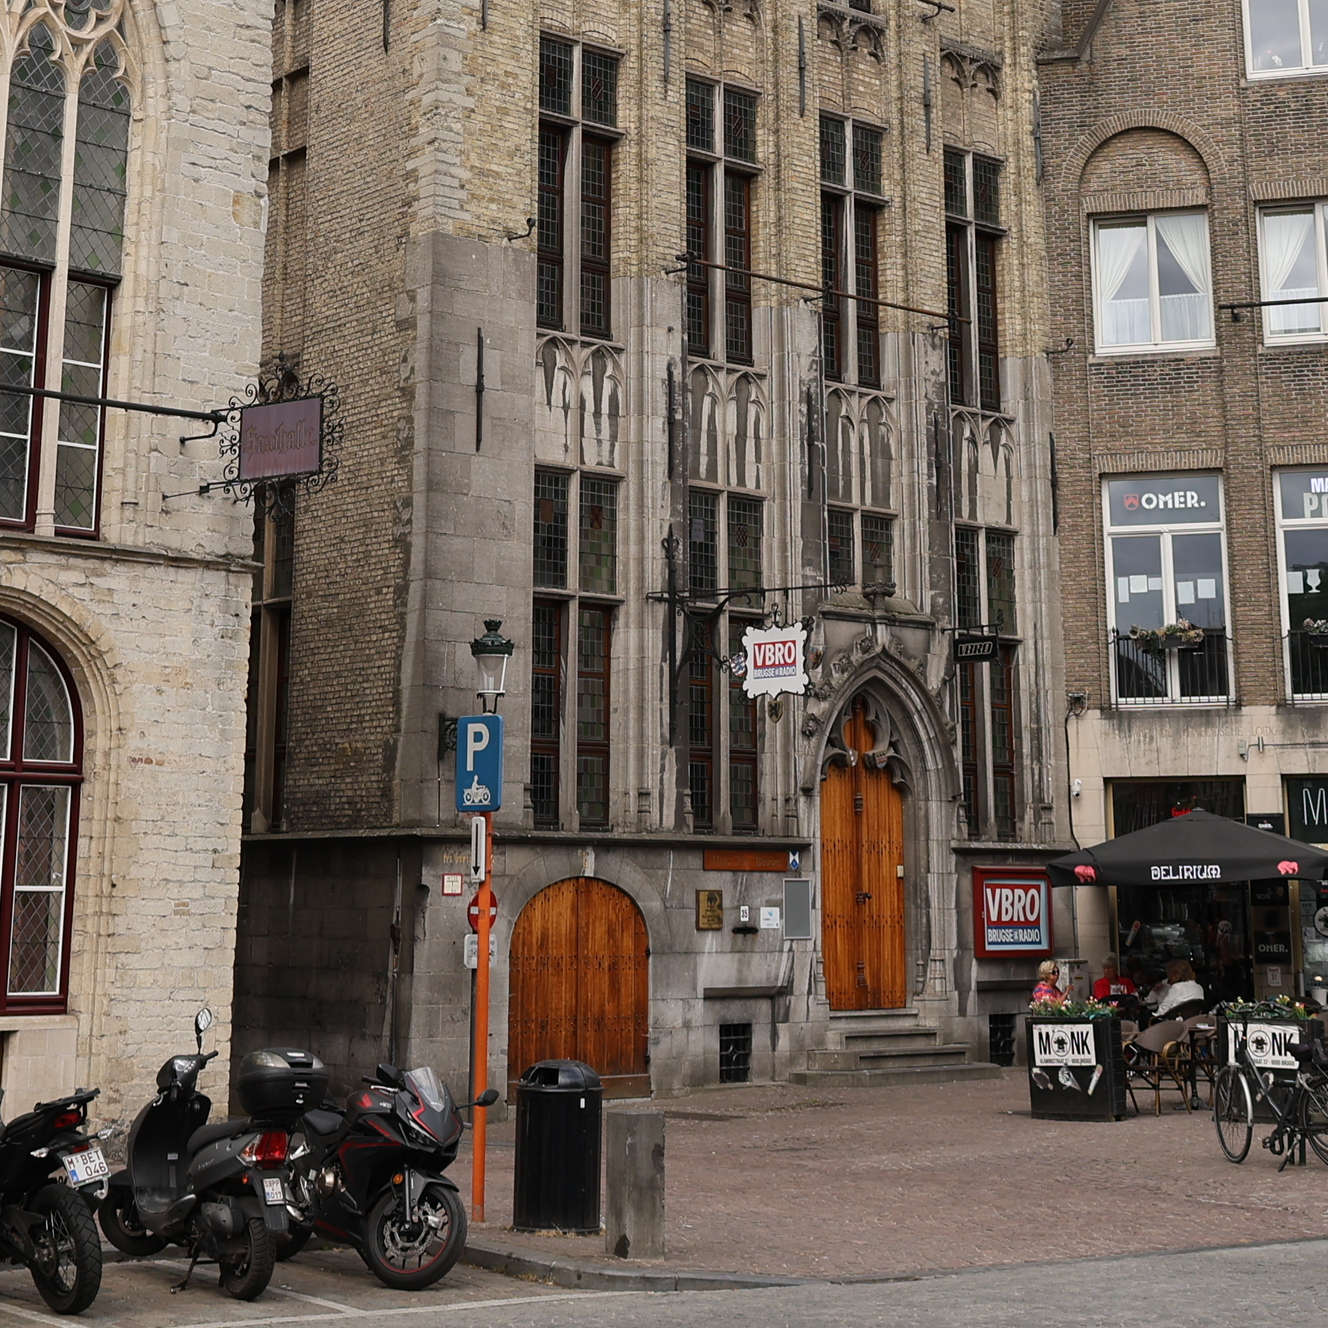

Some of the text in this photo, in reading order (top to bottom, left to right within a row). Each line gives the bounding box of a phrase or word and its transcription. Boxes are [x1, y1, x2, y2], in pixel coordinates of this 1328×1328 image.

[1141, 491, 1206, 510] OMER.
[754, 641, 796, 666] VBRO
[466, 723, 490, 772] P
[1150, 865, 1222, 880] DELIRIUM
[986, 887, 1040, 923] VBRO
[988, 928, 1041, 943] BRUGSE RADIO
[84, 1161, 107, 1177] 046
